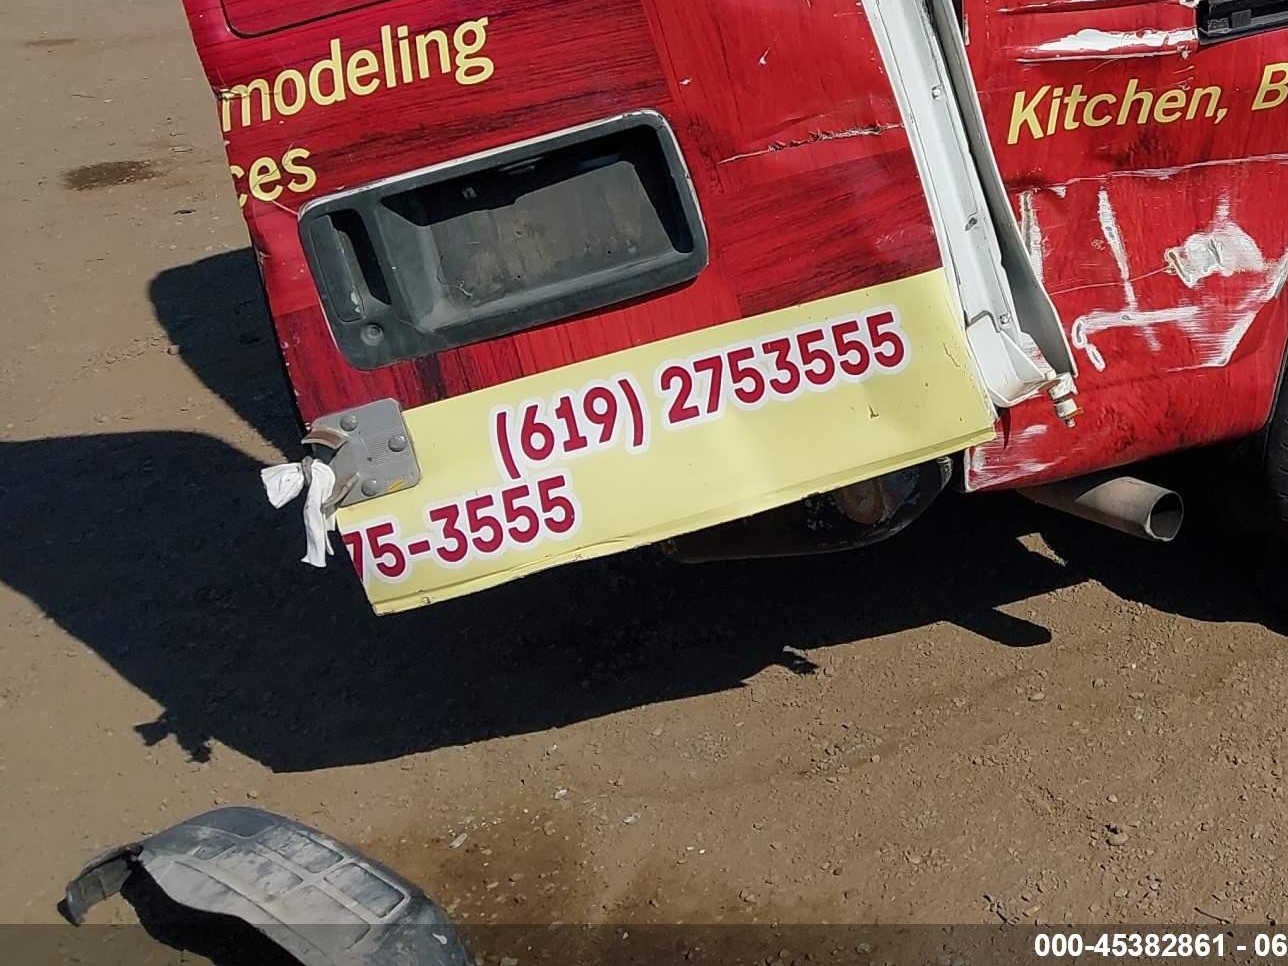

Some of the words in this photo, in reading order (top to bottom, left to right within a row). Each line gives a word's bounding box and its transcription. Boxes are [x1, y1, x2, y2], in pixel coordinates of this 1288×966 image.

[221, 17, 494, 132] modeling
[1007, 79, 1228, 145] Kitchen,
[496, 379, 645, 479] (619)
[660, 311, 904, 425] 2753555
[342, 475, 576, 582] 75-3555
